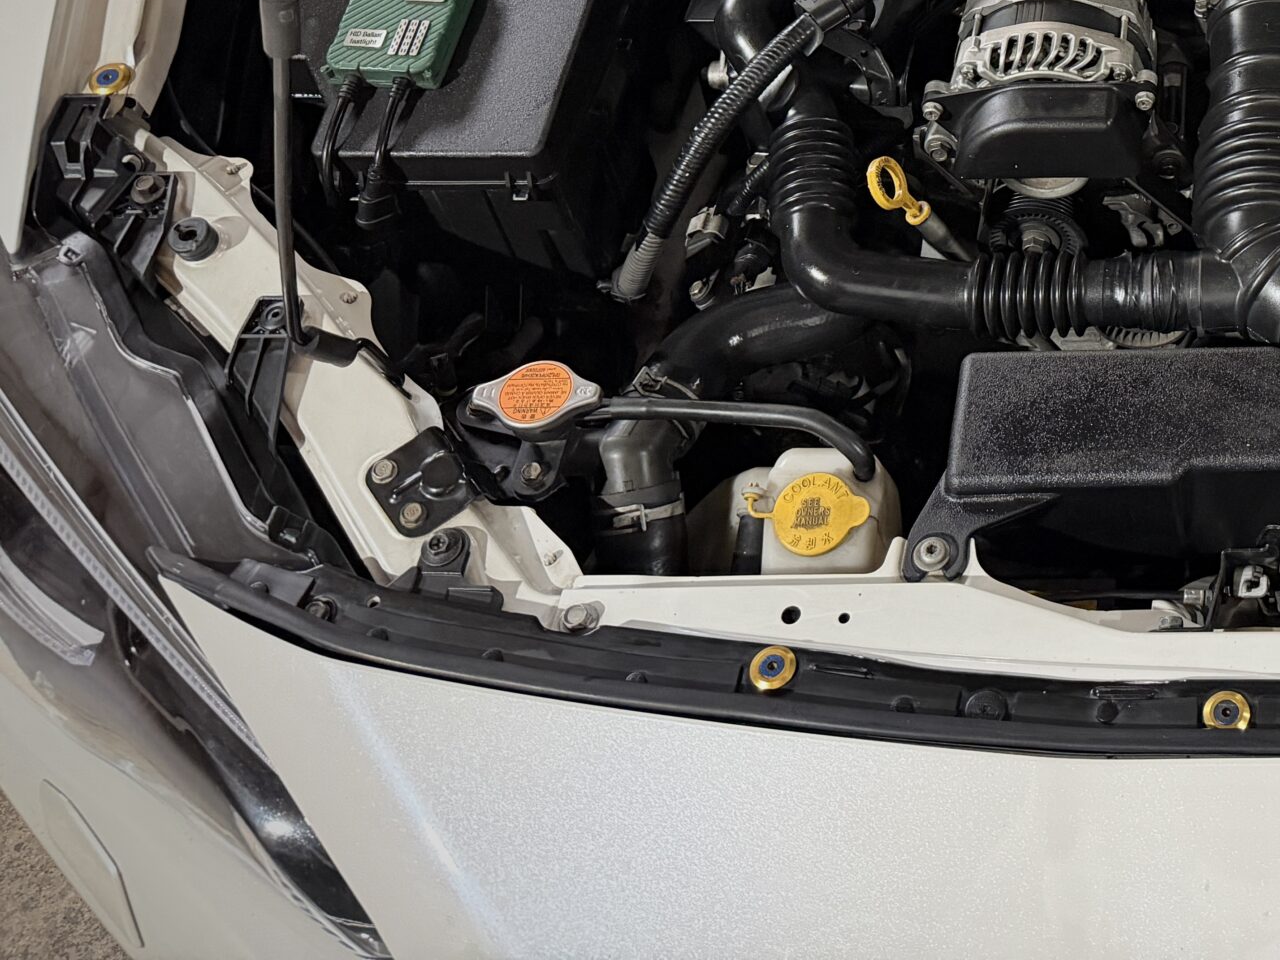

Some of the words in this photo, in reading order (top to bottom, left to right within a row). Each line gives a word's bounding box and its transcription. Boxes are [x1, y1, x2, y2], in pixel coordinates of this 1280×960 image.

[783, 476, 849, 503] COOLANT
[801, 497, 821, 507] SEE
[796, 506, 831, 517] OWNERS
[792, 516, 830, 528] MANUAL
